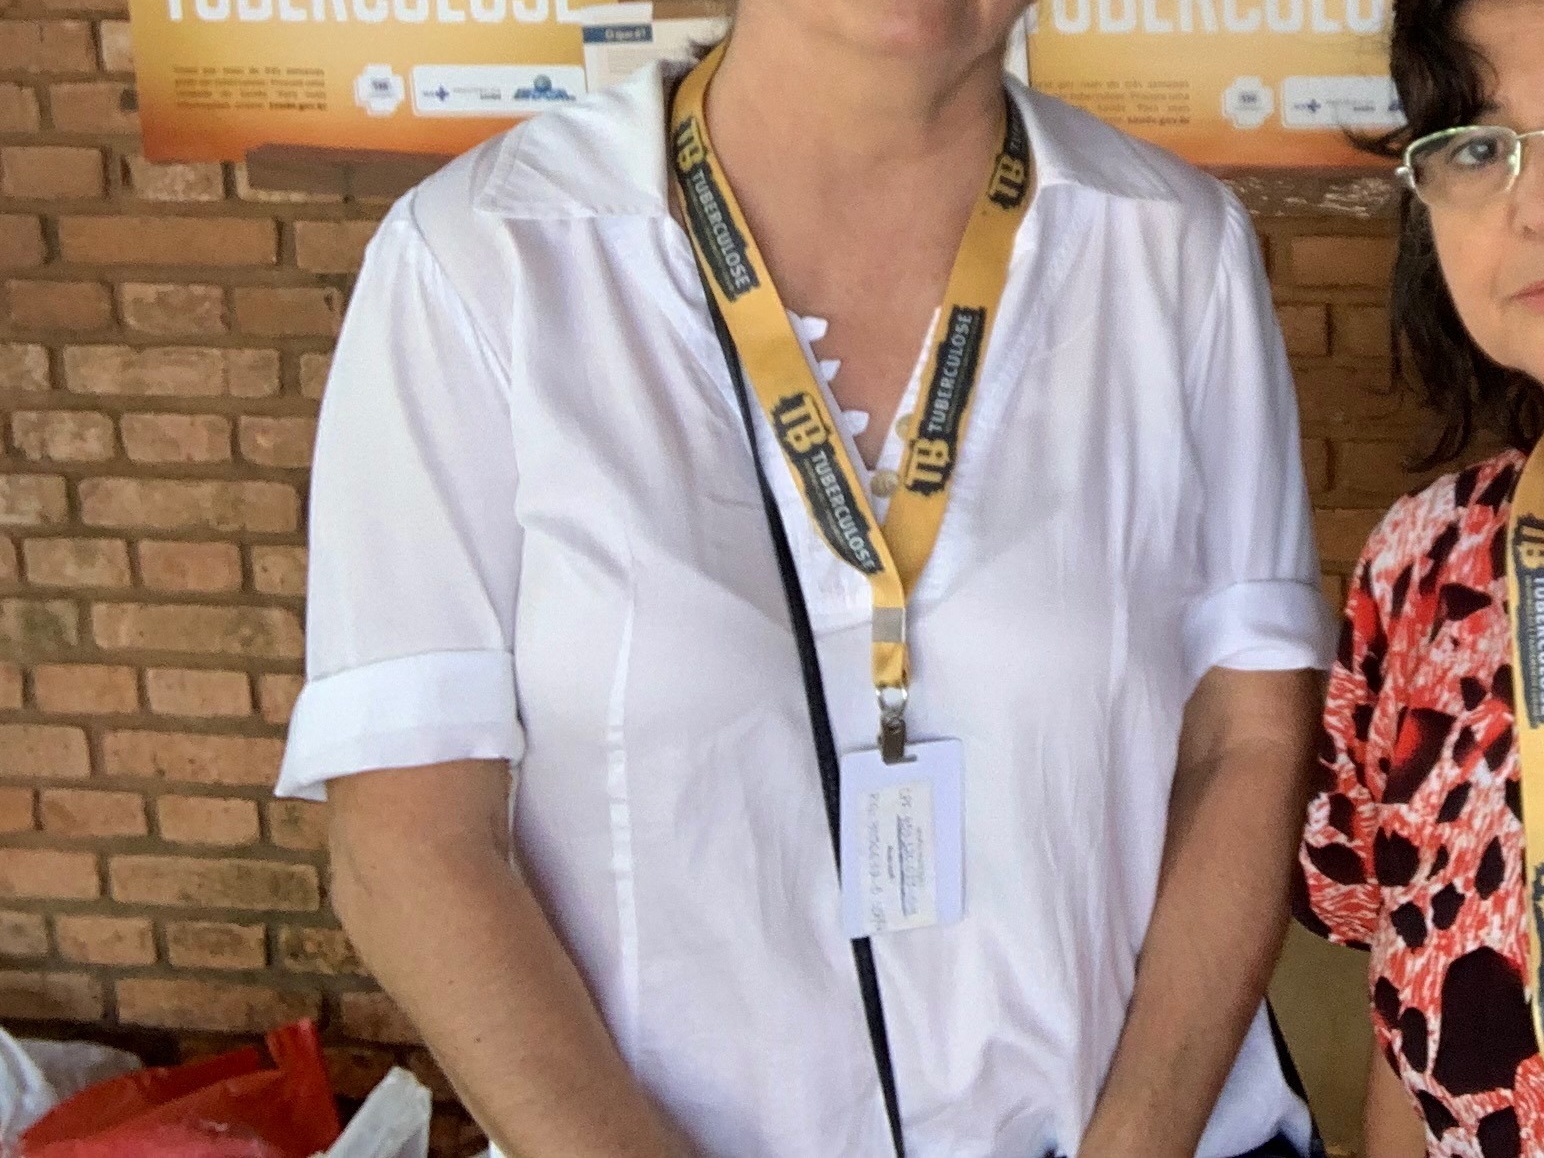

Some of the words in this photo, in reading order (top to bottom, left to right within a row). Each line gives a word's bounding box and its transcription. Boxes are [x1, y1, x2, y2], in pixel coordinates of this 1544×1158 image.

[987, 154, 1025, 199] TB
[692, 168, 751, 289] TUBERCULOSE
[926, 313, 973, 433] TUBERCULOSE
[780, 395, 827, 454] TB
[905, 439, 950, 488] TB
[812, 448, 876, 572] TUBERCULOSE
